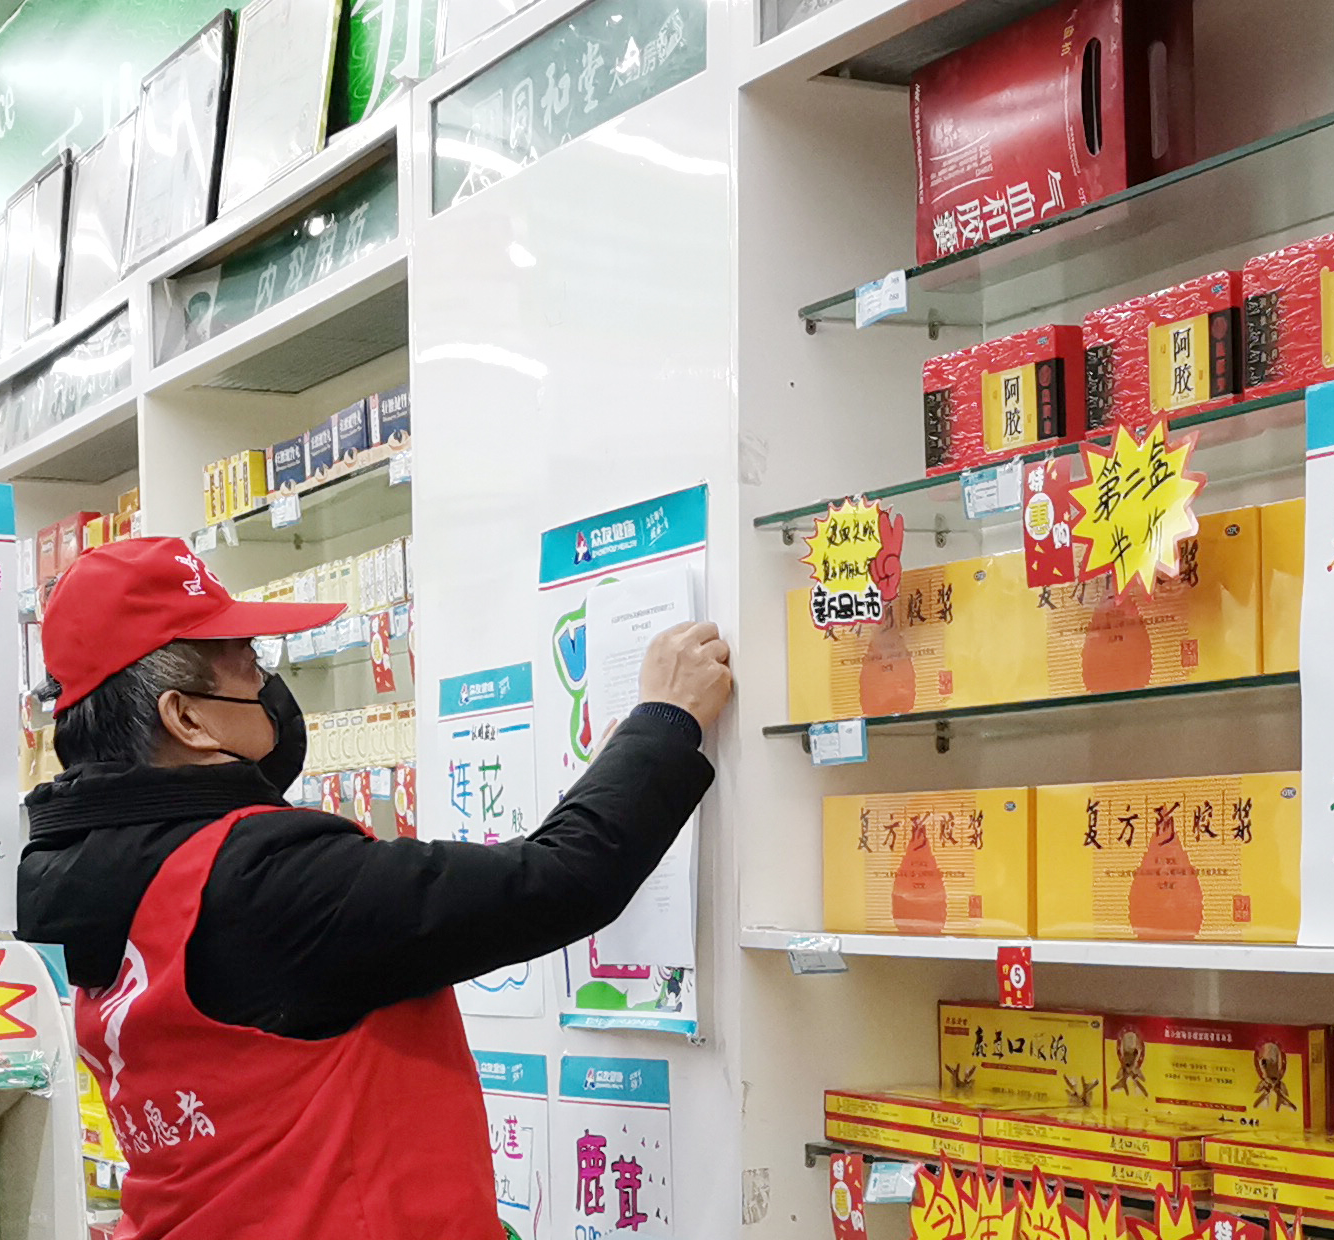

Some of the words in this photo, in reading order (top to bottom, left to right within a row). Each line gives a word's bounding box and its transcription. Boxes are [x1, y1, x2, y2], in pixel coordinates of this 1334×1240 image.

[1172, 327, 1195, 395] 阿胶
[1003, 377, 1023, 437] 阿胶
[812, 584, 882, 624] 新品上市
[448, 754, 505, 824] 连花
[856, 805, 985, 854] 复方阿胶浆
[1082, 795, 1253, 851] 复方阿胶浆
[109, 1090, 216, 1155] 志愿者
[575, 1128, 649, 1232] 鹿茸
